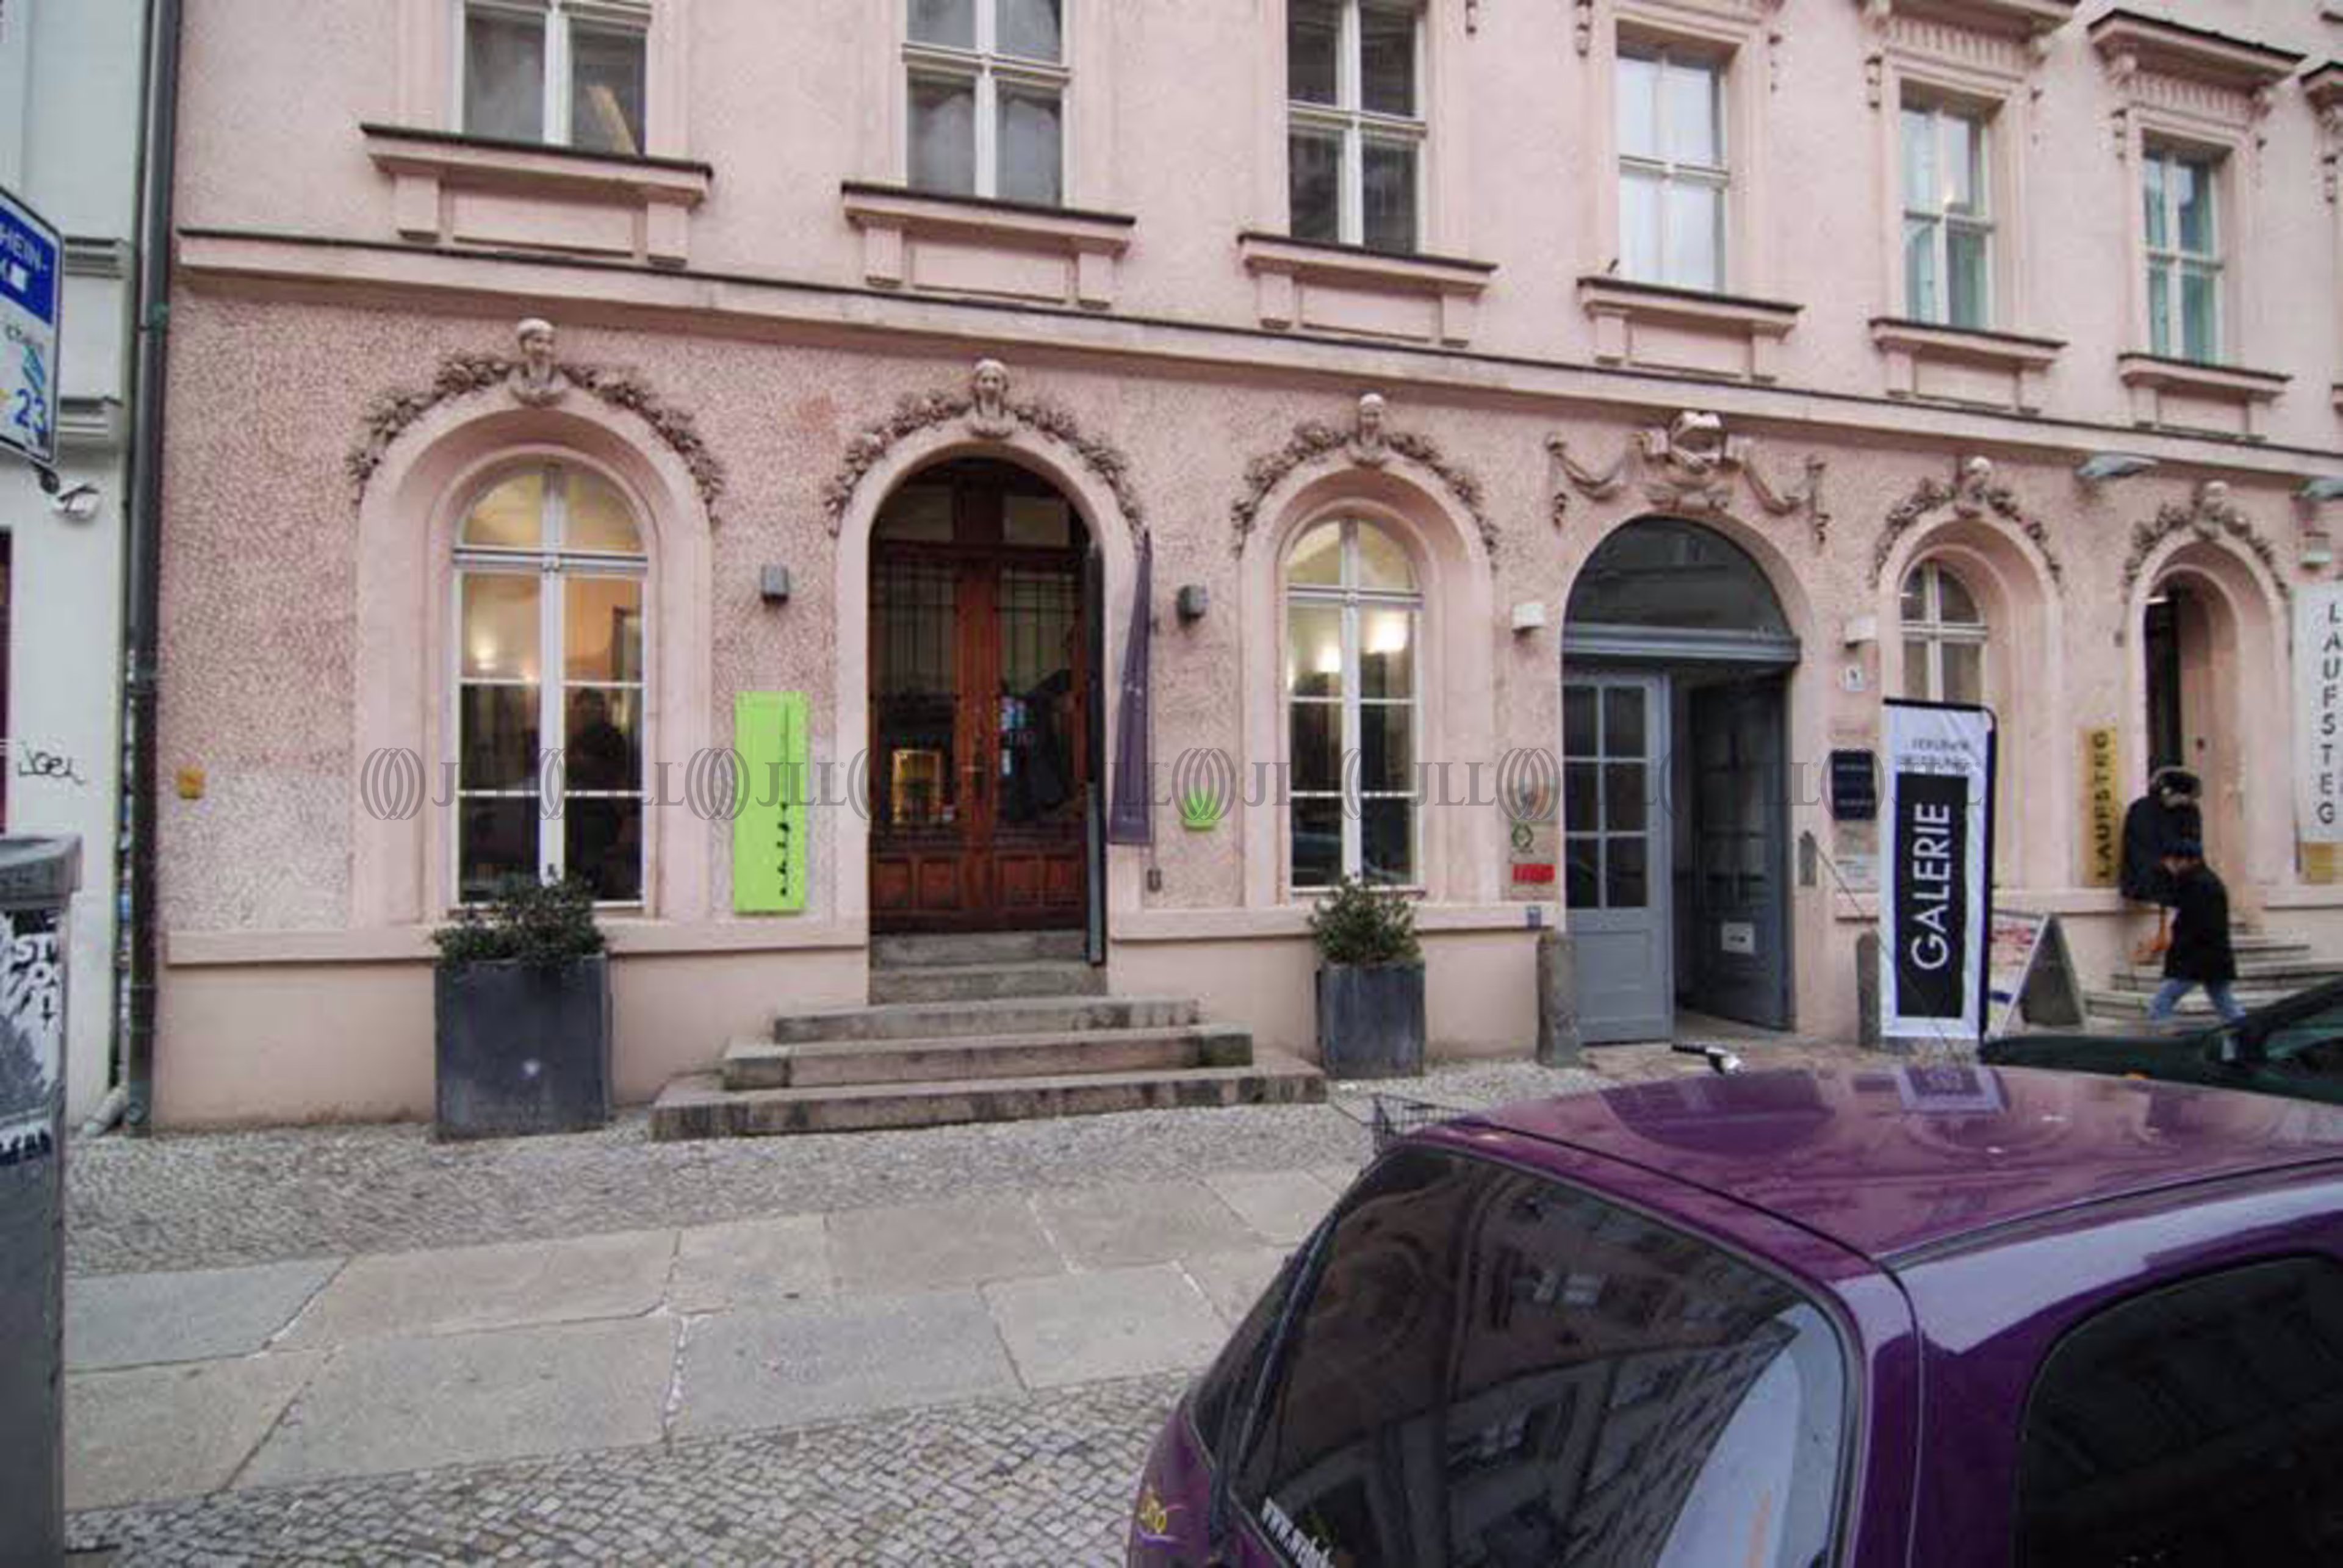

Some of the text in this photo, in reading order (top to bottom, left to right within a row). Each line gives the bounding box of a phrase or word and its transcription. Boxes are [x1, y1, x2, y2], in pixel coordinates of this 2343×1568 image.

[2317, 603, 2342, 824] LAUFSTEG
[1910, 802, 1950, 969] GALERIE
[2093, 730, 2111, 879] LAUFSTEG
